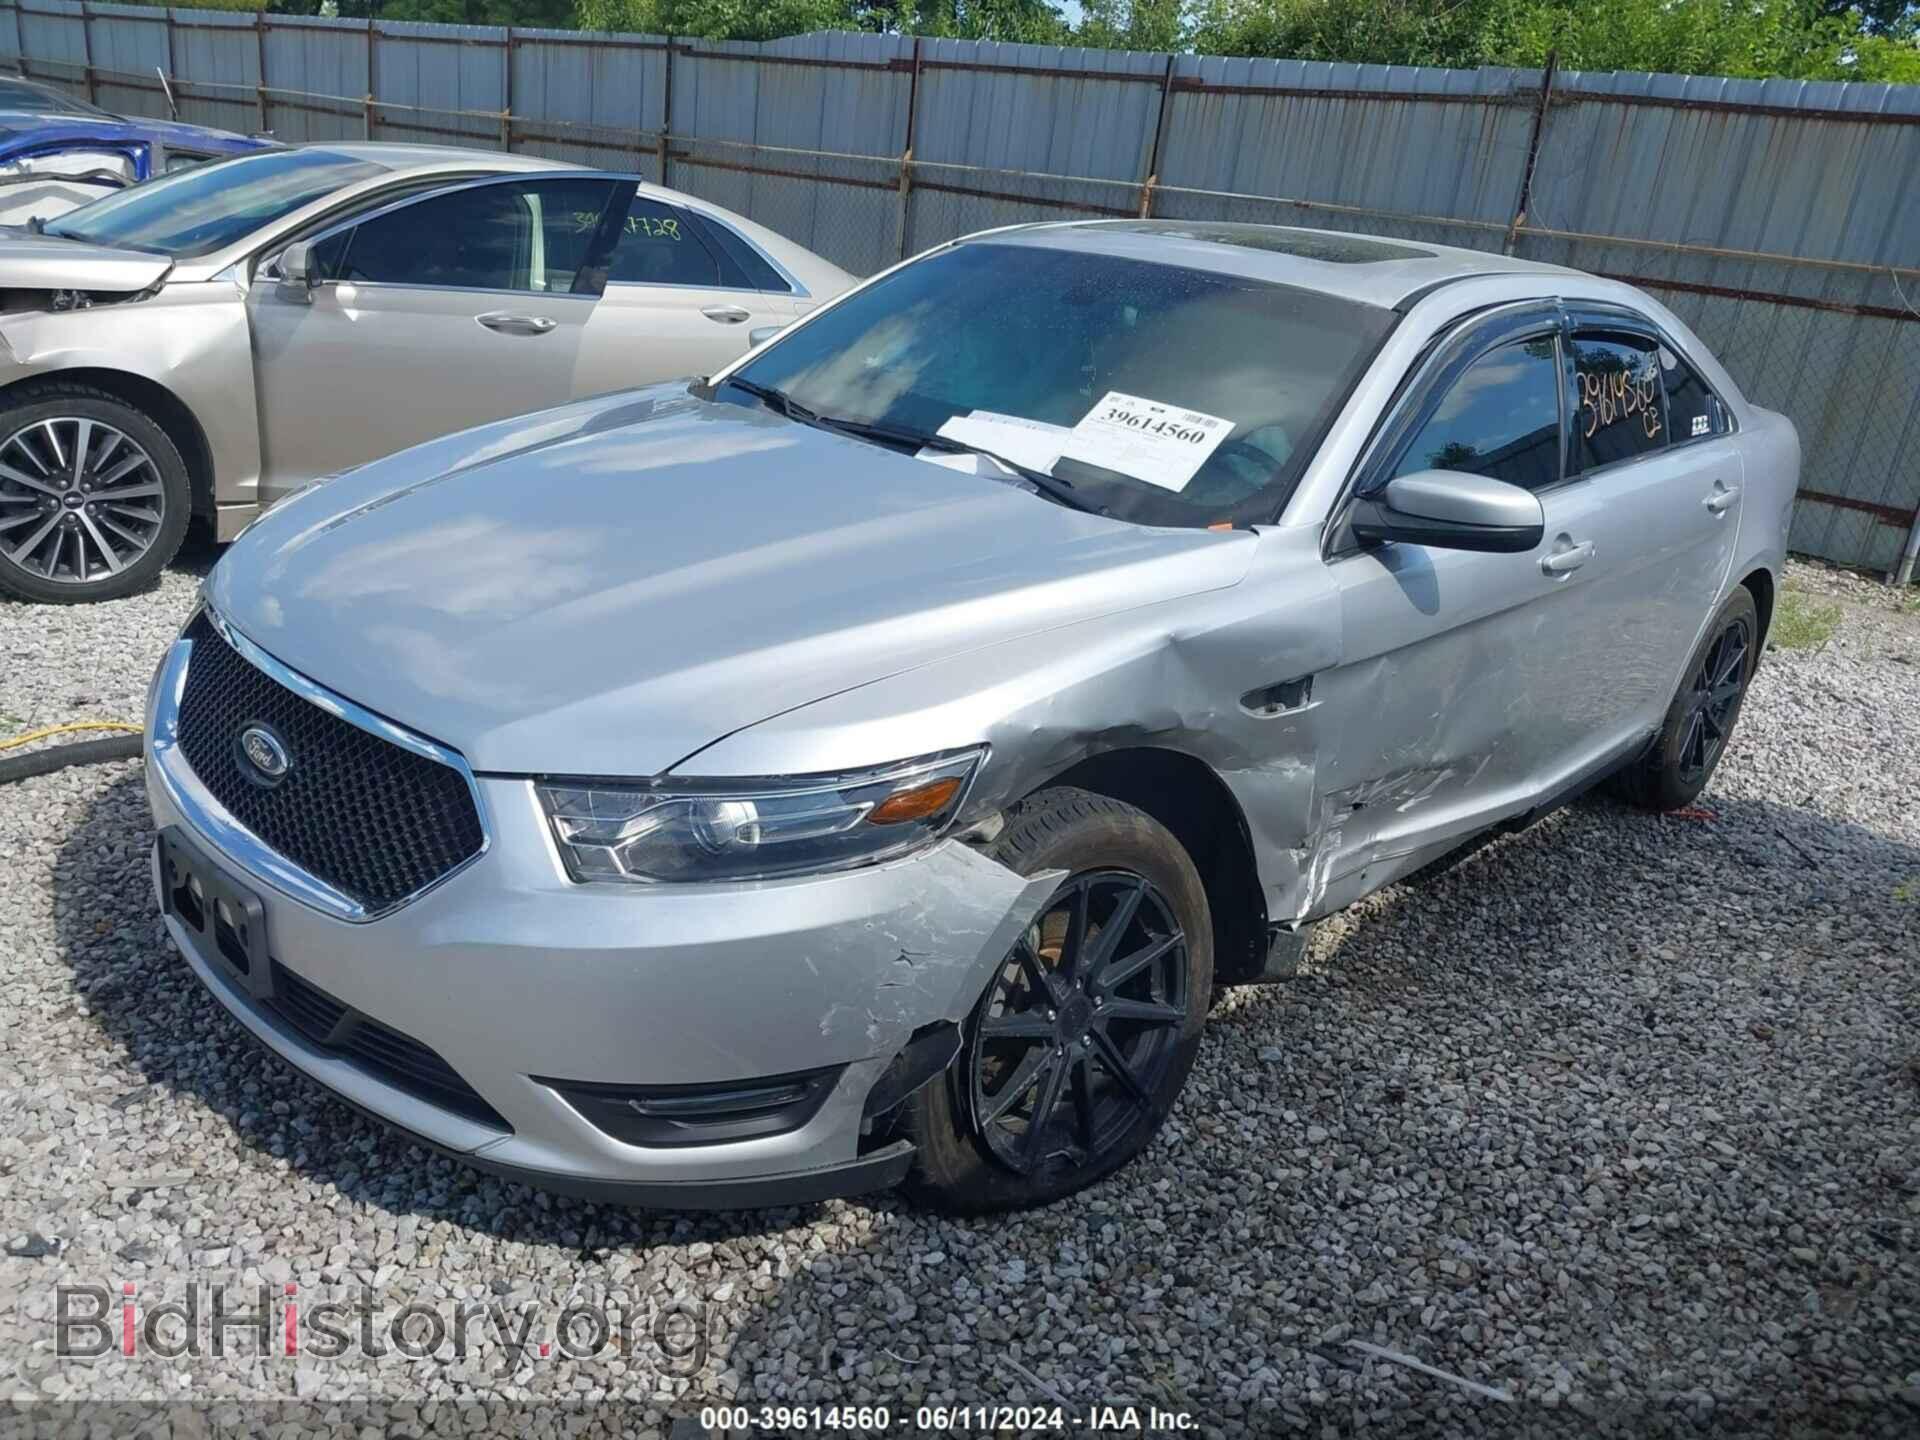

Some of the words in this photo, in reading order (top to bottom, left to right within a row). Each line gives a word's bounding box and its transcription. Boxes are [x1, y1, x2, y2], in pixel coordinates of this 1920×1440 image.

[573, 212, 681, 241] 397728
[1576, 370, 1655, 438] 39614560
[1101, 408, 1206, 444] 39614560
[247, 736, 274, 768] Ford
